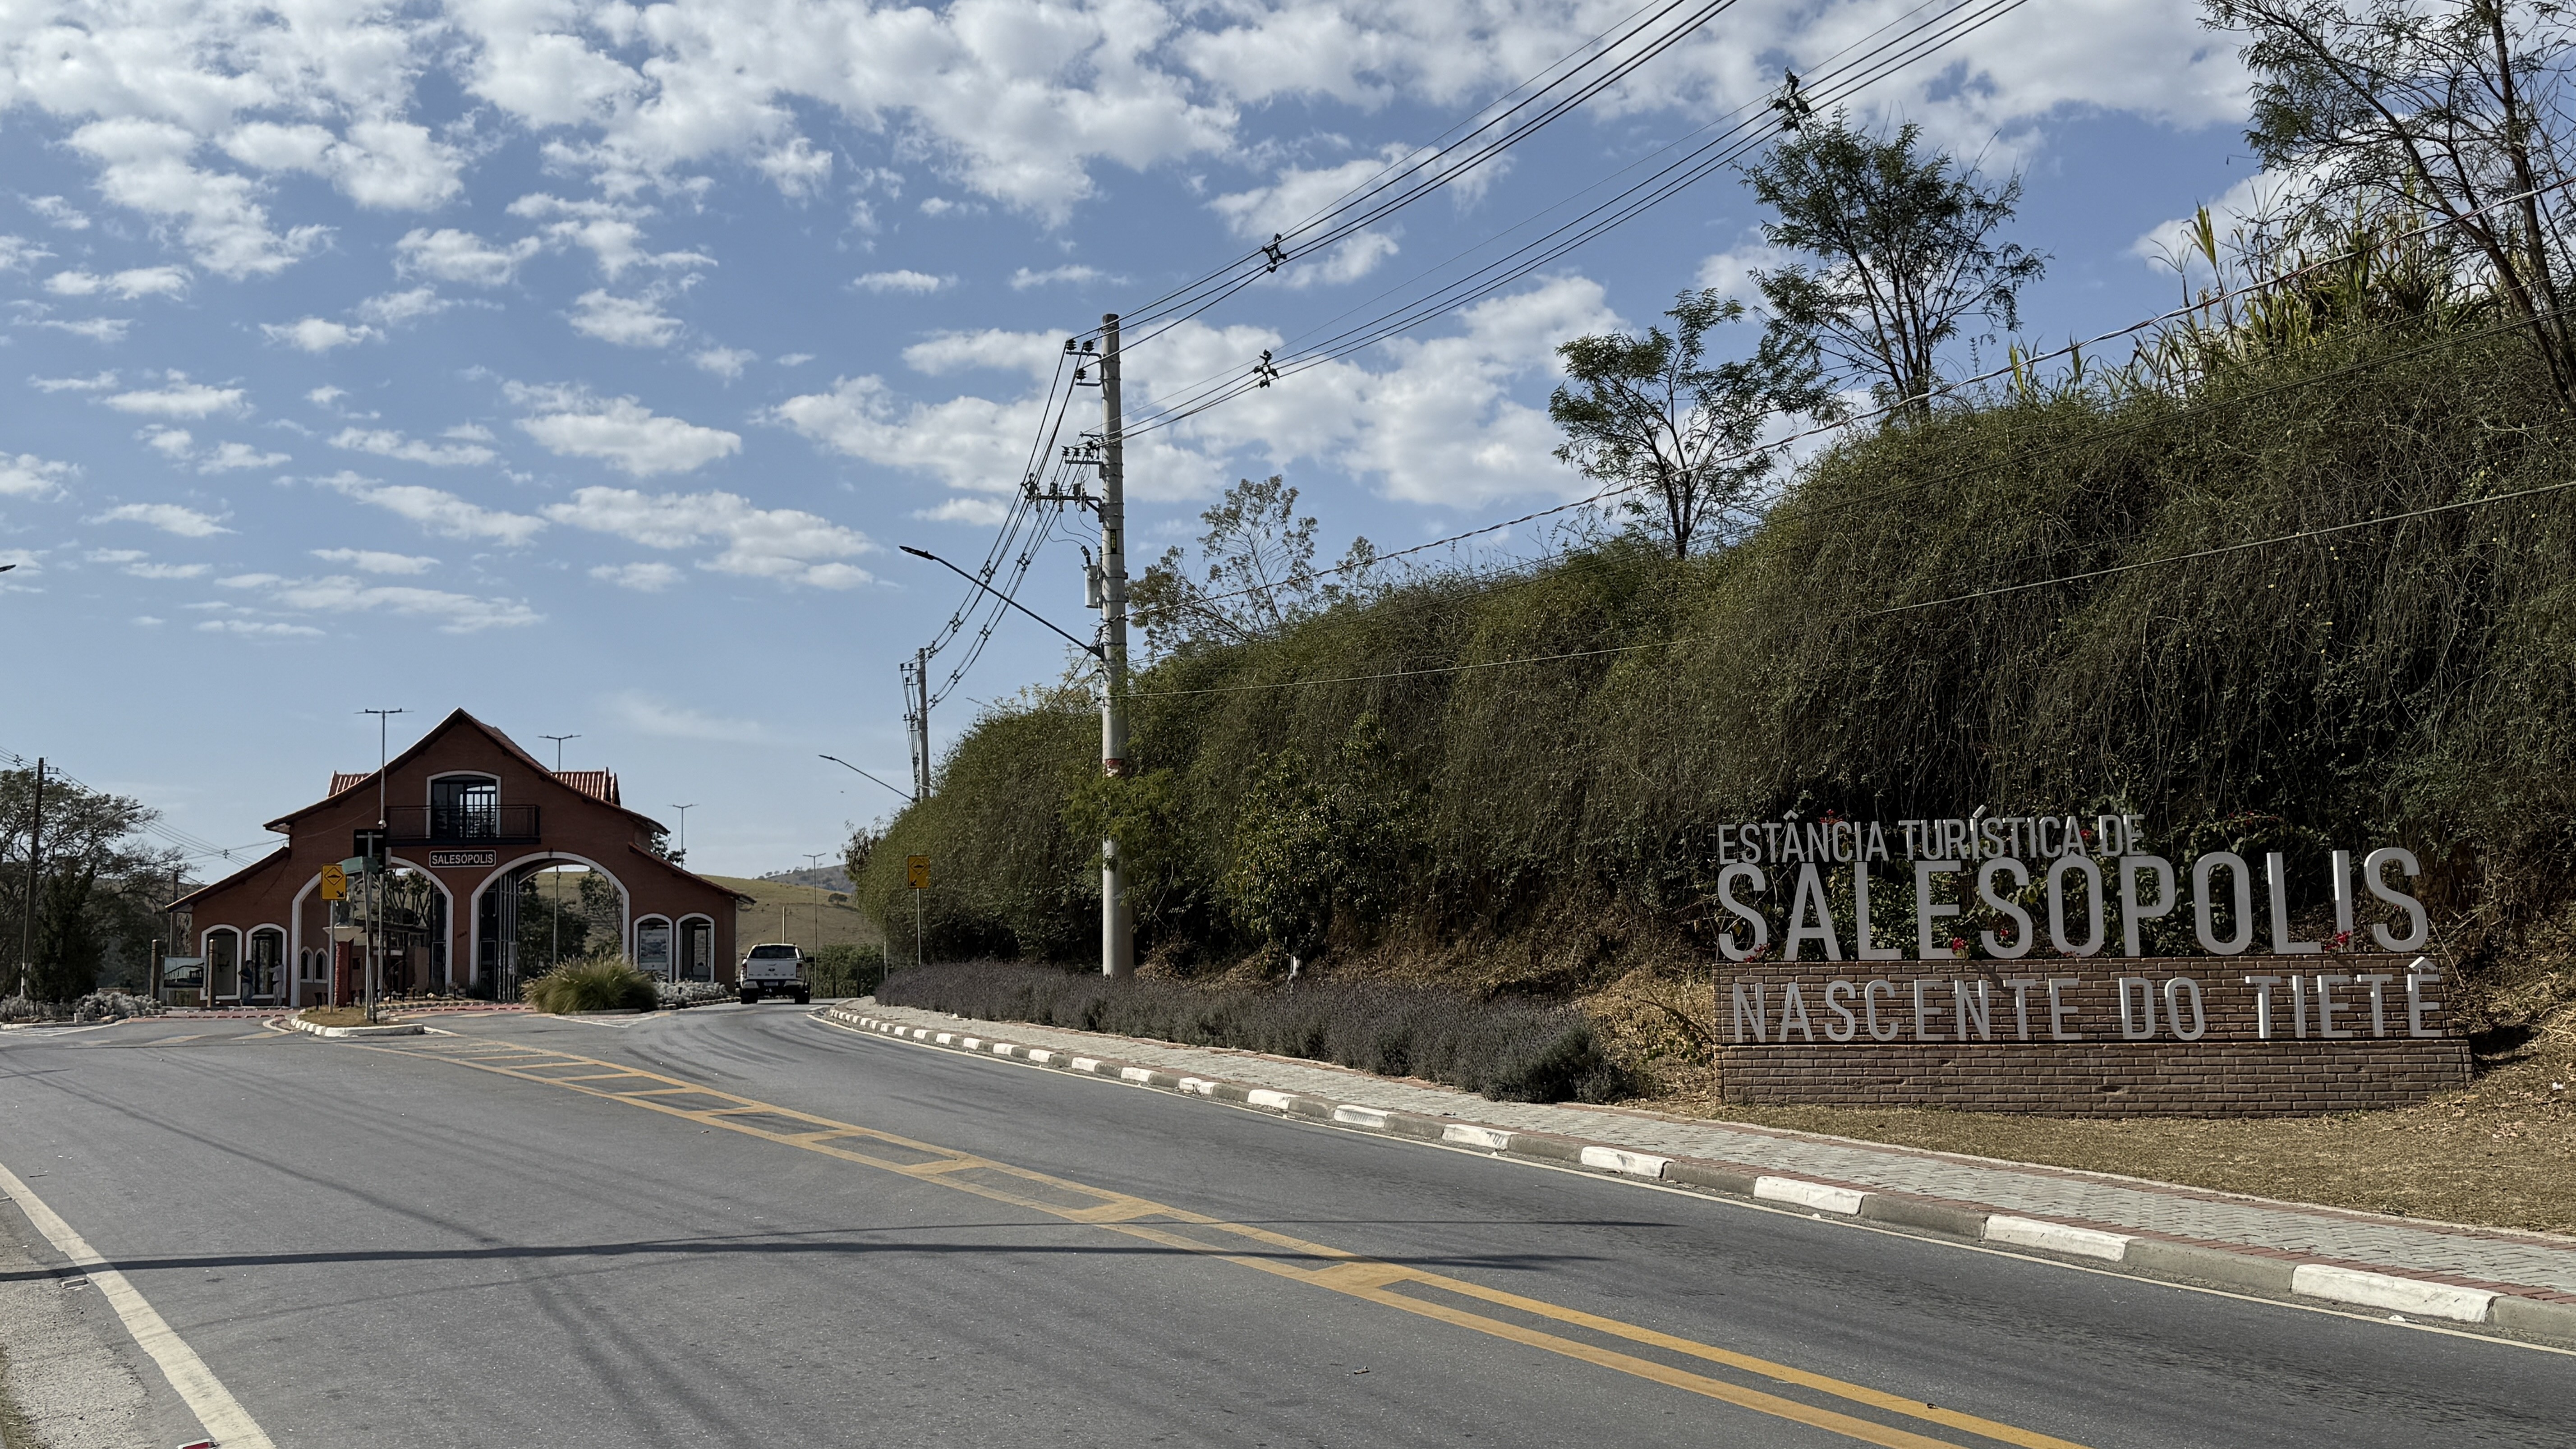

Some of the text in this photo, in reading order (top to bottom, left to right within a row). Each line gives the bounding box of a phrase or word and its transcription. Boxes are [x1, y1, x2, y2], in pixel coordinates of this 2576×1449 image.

[432, 853, 493, 865] SALESÓPOLIS
[1718, 805, 2148, 865] ESTÂNCIA TURÍSTICA DE
[1717, 847, 2429, 962] SALESÓPOLIS
[1732, 956, 2444, 1043] NASCENTE DO TIETÊ
